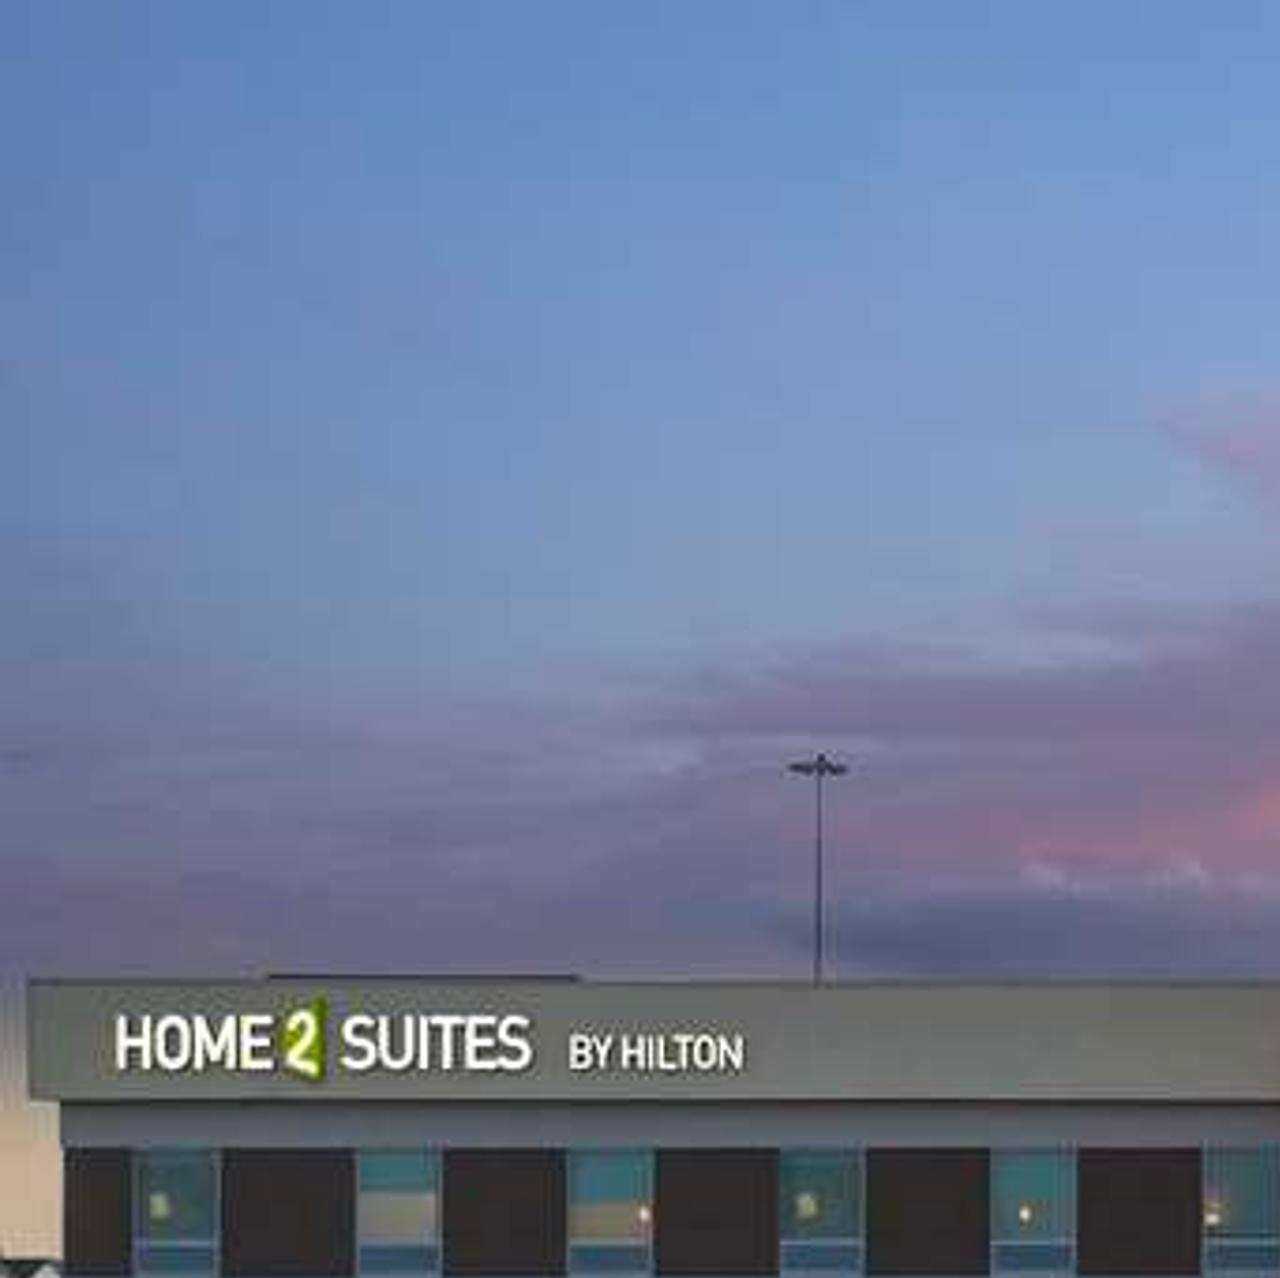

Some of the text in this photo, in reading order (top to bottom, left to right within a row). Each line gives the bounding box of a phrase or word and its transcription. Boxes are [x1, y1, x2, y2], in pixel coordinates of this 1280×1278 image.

[342, 1014, 533, 1070] SUITES
[568, 1034, 613, 1070] BY
[621, 1034, 745, 1070] HILTON
